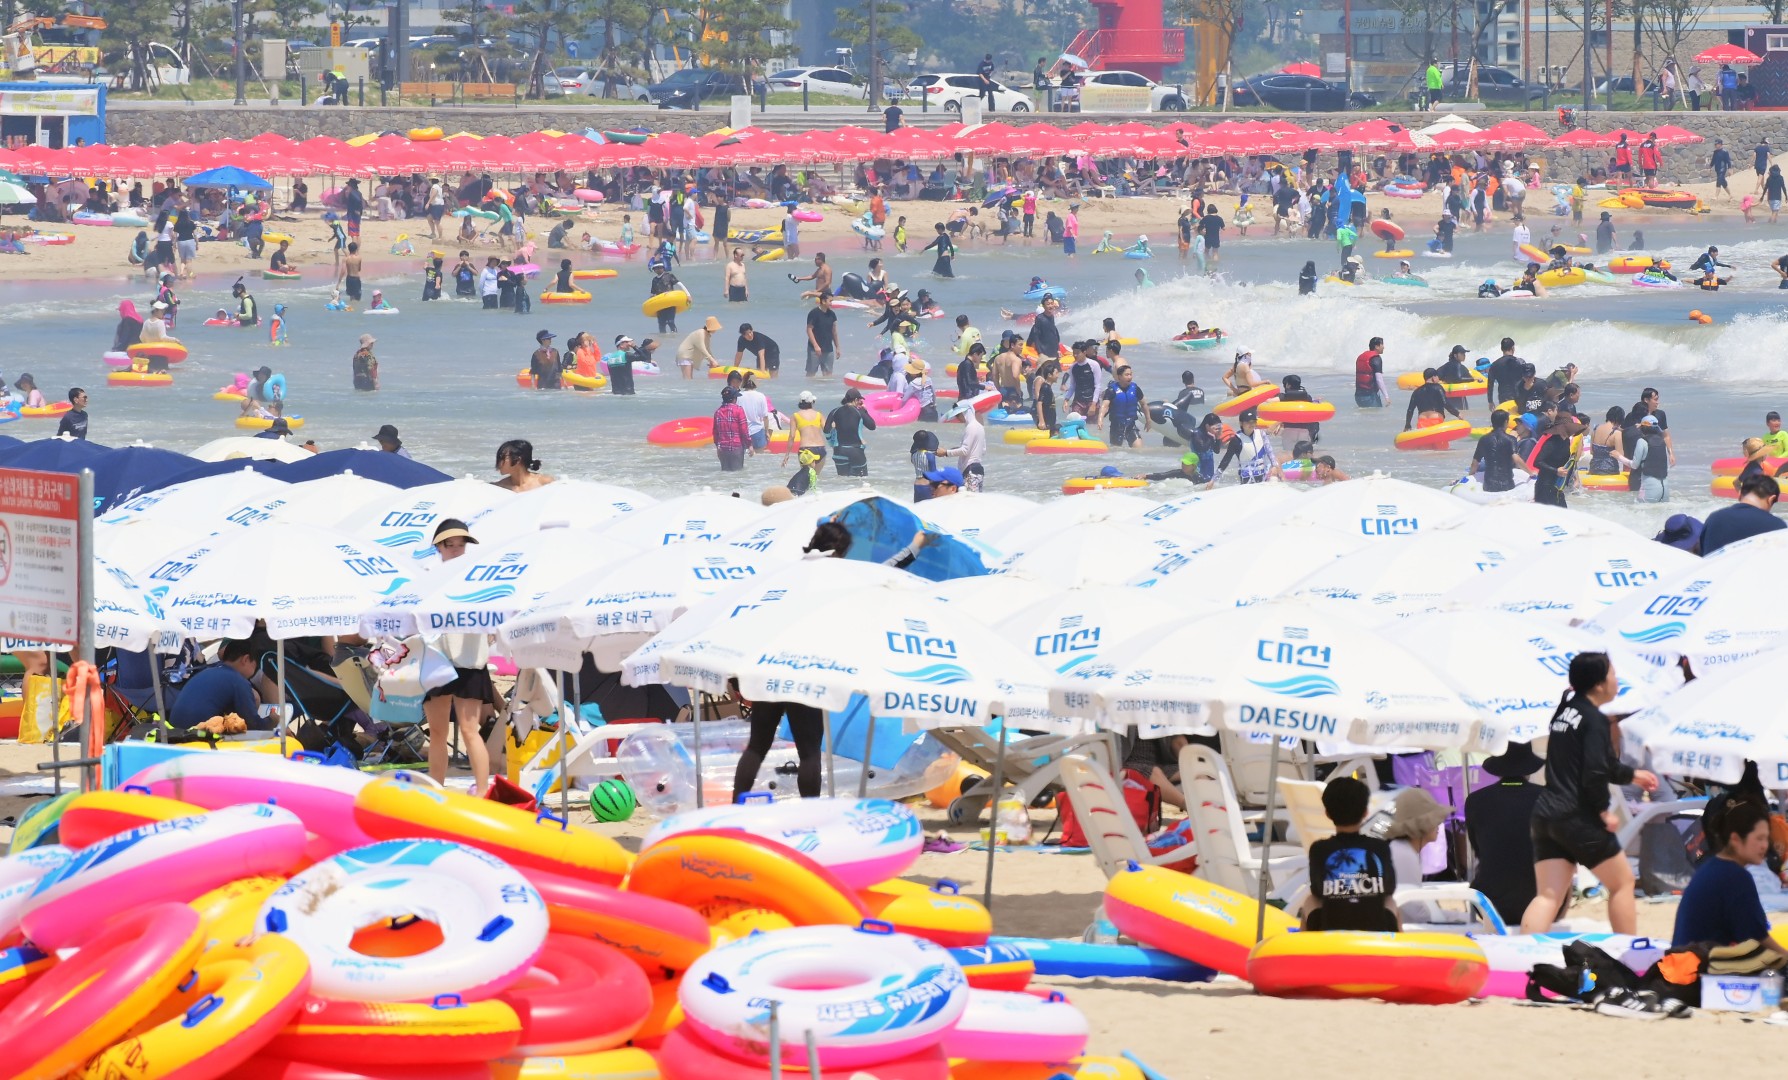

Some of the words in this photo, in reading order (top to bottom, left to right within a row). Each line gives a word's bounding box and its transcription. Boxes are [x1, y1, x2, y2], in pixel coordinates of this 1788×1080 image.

[380, 510, 437, 528] 대선
[464, 563, 528, 581] 대선
[1644, 595, 1708, 616] 대선
[430, 611, 504, 629] DAESUN
[596, 610, 653, 627] 해운대구
[96, 623, 129, 641] 운대구
[1035, 627, 1101, 656] 대선
[886, 631, 957, 659] 대선
[1257, 639, 1331, 669] 대선
[766, 679, 826, 699] 해운대구
[884, 691, 977, 717] DAESUN
[1239, 704, 1336, 735] DAESUN
[1323, 877, 1385, 896] BEACH
